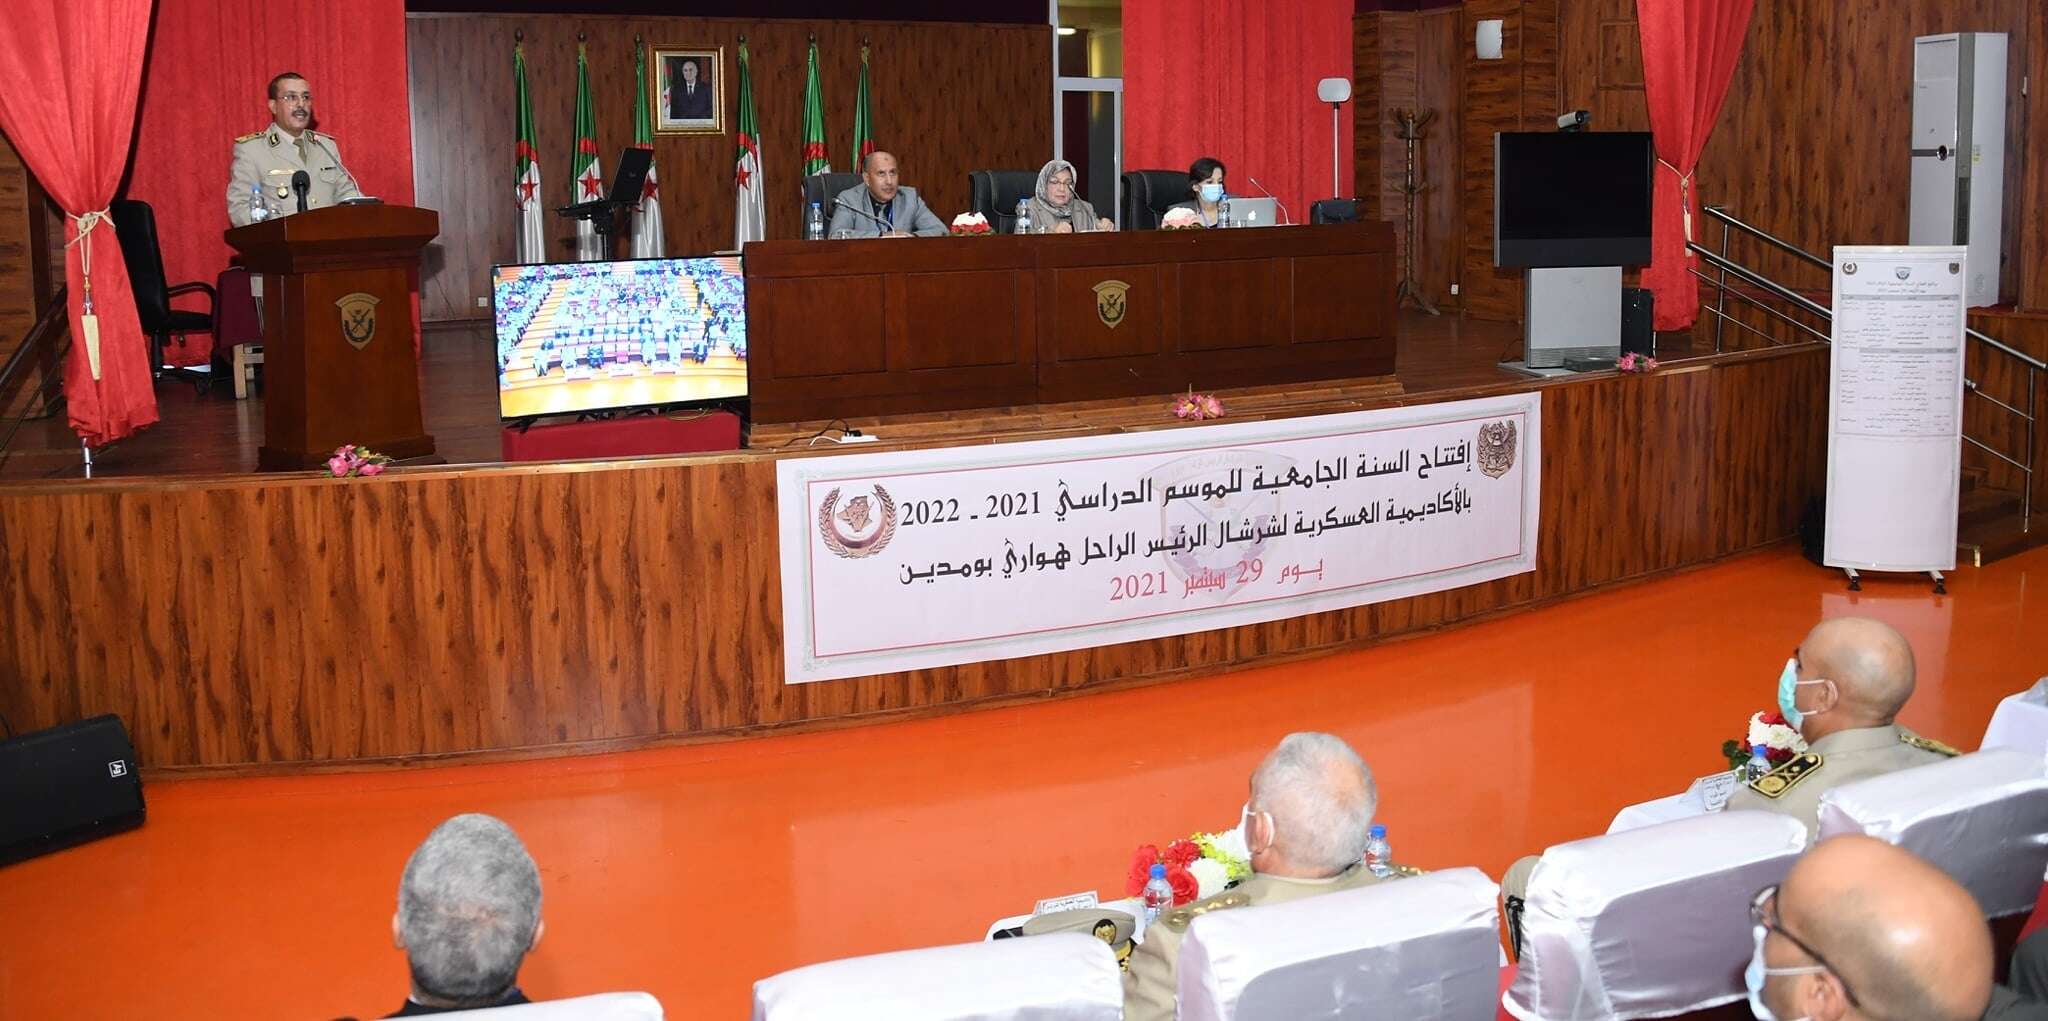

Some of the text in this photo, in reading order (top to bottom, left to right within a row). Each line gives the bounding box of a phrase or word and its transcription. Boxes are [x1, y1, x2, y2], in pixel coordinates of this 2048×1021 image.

[1252, 455, 1349, 495] الجامعية
[1355, 448, 1411, 480] السنة
[1417, 438, 1472, 480] إفتتاح
[984, 491, 1042, 520] 2021
[1055, 478, 1154, 523] الدراسي
[1162, 467, 1243, 508] للموسم
[899, 498, 961, 527] 2022
[899, 482, 1472, 585] بالأكاديمية العسكرية لشرشال الرئيس الراحل هواري بومدين
[1110, 558, 1324, 602] يوم 29 سبتمبر 2021
